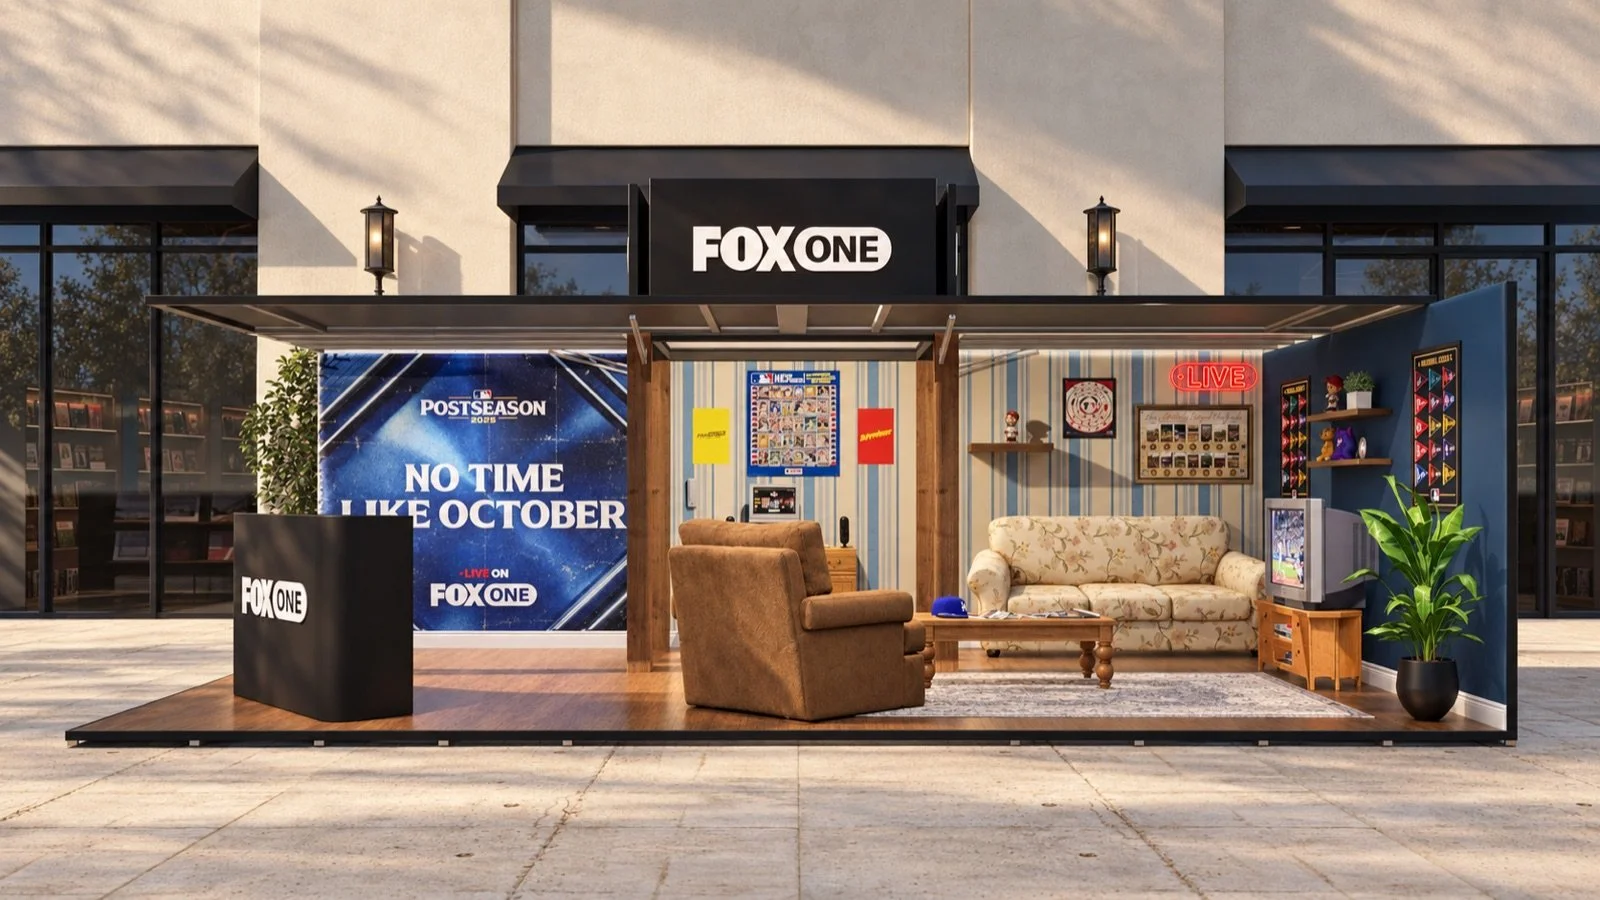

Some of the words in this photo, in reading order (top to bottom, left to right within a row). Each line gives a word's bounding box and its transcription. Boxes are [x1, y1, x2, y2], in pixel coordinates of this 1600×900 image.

[692, 226, 796, 272] FOX
[805, 235, 879, 263] ONE
[1187, 366, 1246, 388] LIVE
[420, 399, 546, 416] POSTSEASON
[471, 416, 497, 424] 2025
[405, 463, 460, 493] NO
[468, 463, 565, 493] TIME
[439, 499, 627, 529] OCTOBER
[465, 568, 489, 578] LIVE
[491, 568, 509, 578] ON
[241, 576, 275, 619] FOX
[277, 588, 302, 615] ONE
[430, 583, 485, 607] FOX
[490, 588, 530, 602] ONE
